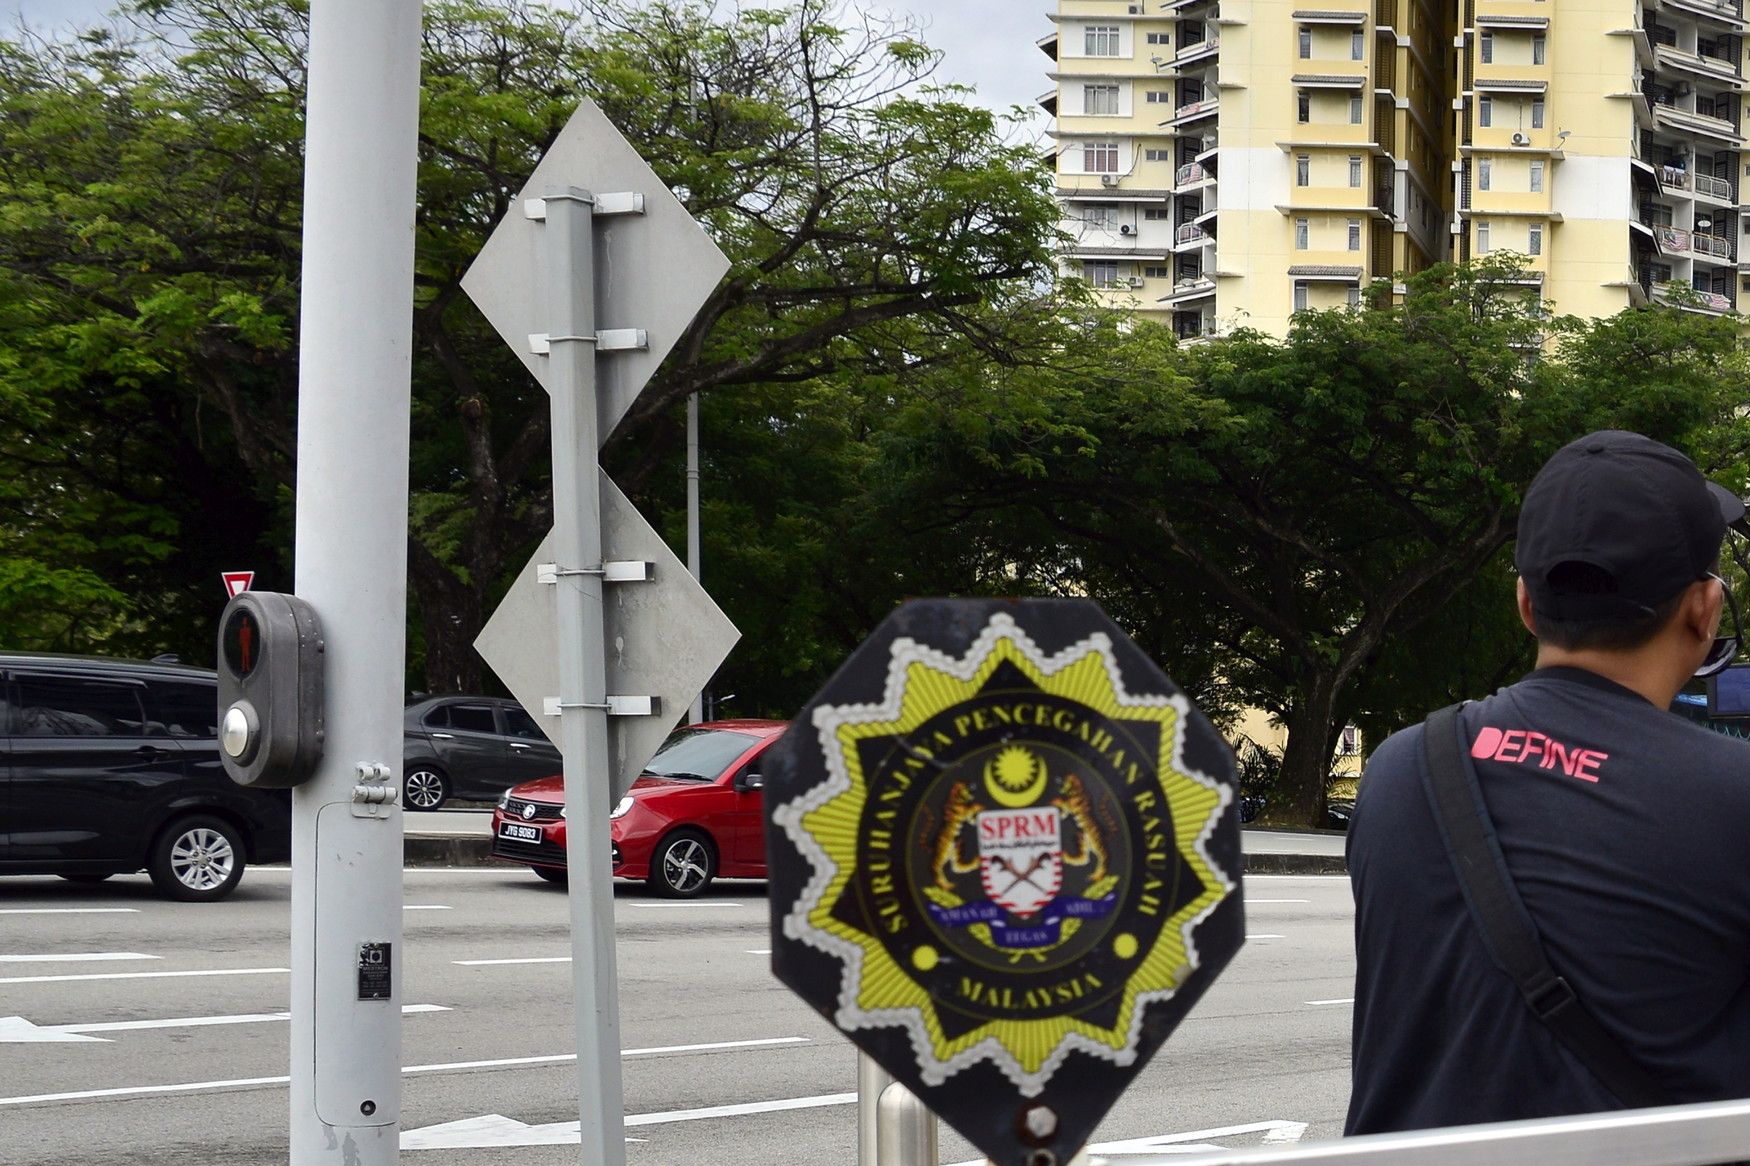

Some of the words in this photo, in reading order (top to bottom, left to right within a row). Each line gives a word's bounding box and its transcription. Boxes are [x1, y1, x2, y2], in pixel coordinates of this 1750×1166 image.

[1471, 726, 1609, 783] DEFINE
[868, 730, 953, 935] SURUHANJAYA
[953, 702, 1145, 785] PENCEGAHAN
[1134, 789, 1168, 917] RASUAH
[980, 813, 1056, 841] SPRM
[958, 973, 1102, 1009] MALAYSIA
